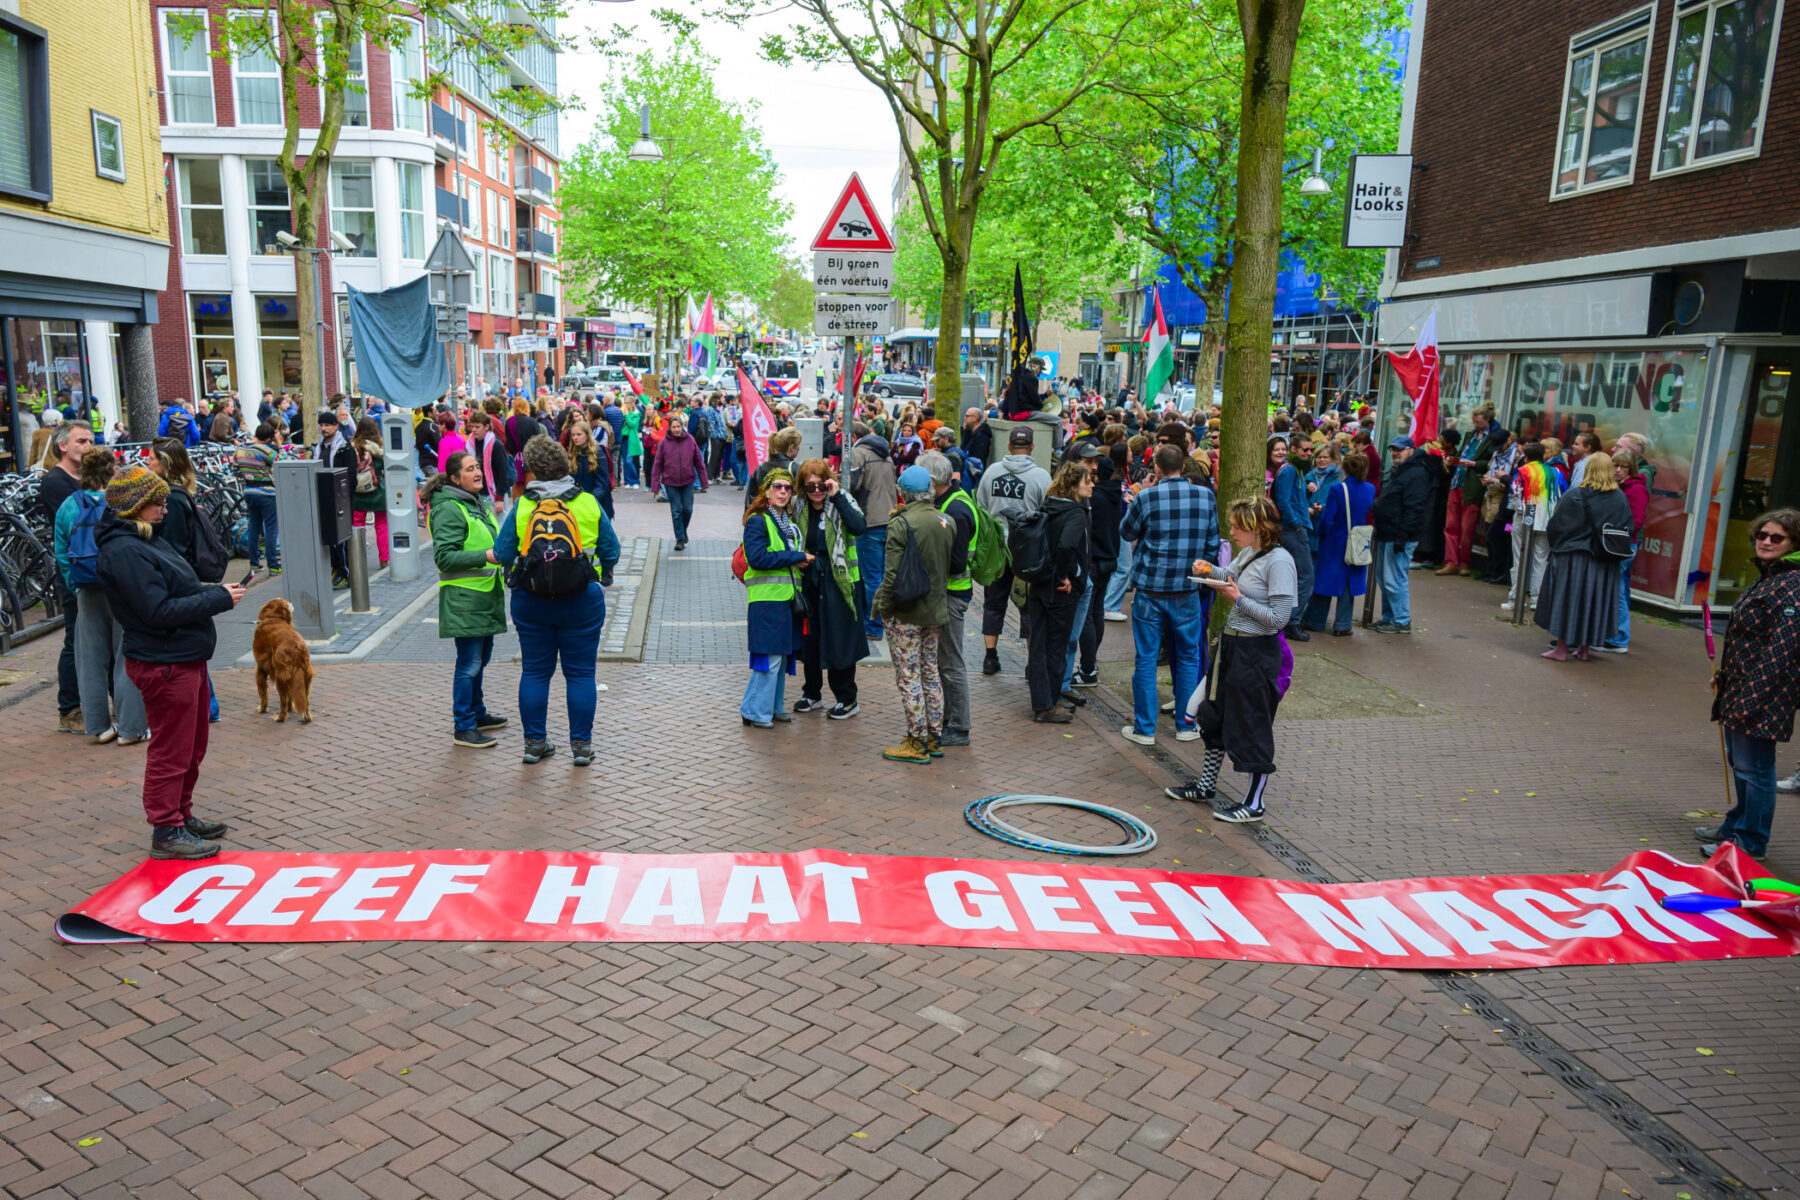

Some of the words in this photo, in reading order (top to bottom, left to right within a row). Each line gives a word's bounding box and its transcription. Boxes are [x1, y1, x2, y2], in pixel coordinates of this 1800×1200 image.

[1355, 182, 1392, 197] Hair
[1354, 197, 1404, 212] Looks
[828, 258, 843, 271] Bij
[847, 260, 879, 271] groen
[817, 274, 837, 286] één
[841, 277, 889, 289] voertuig
[817, 302, 861, 313] stoppen
[865, 303, 888, 312] voor
[827, 319, 841, 330] de
[844, 319, 878, 331] streep
[1519, 362, 1685, 413] SPINNING
[1644, 537, 1662, 555] US
[138, 863, 490, 926] GEEF
[524, 861, 869, 925] HAAT
[925, 870, 1272, 947] GEEN
